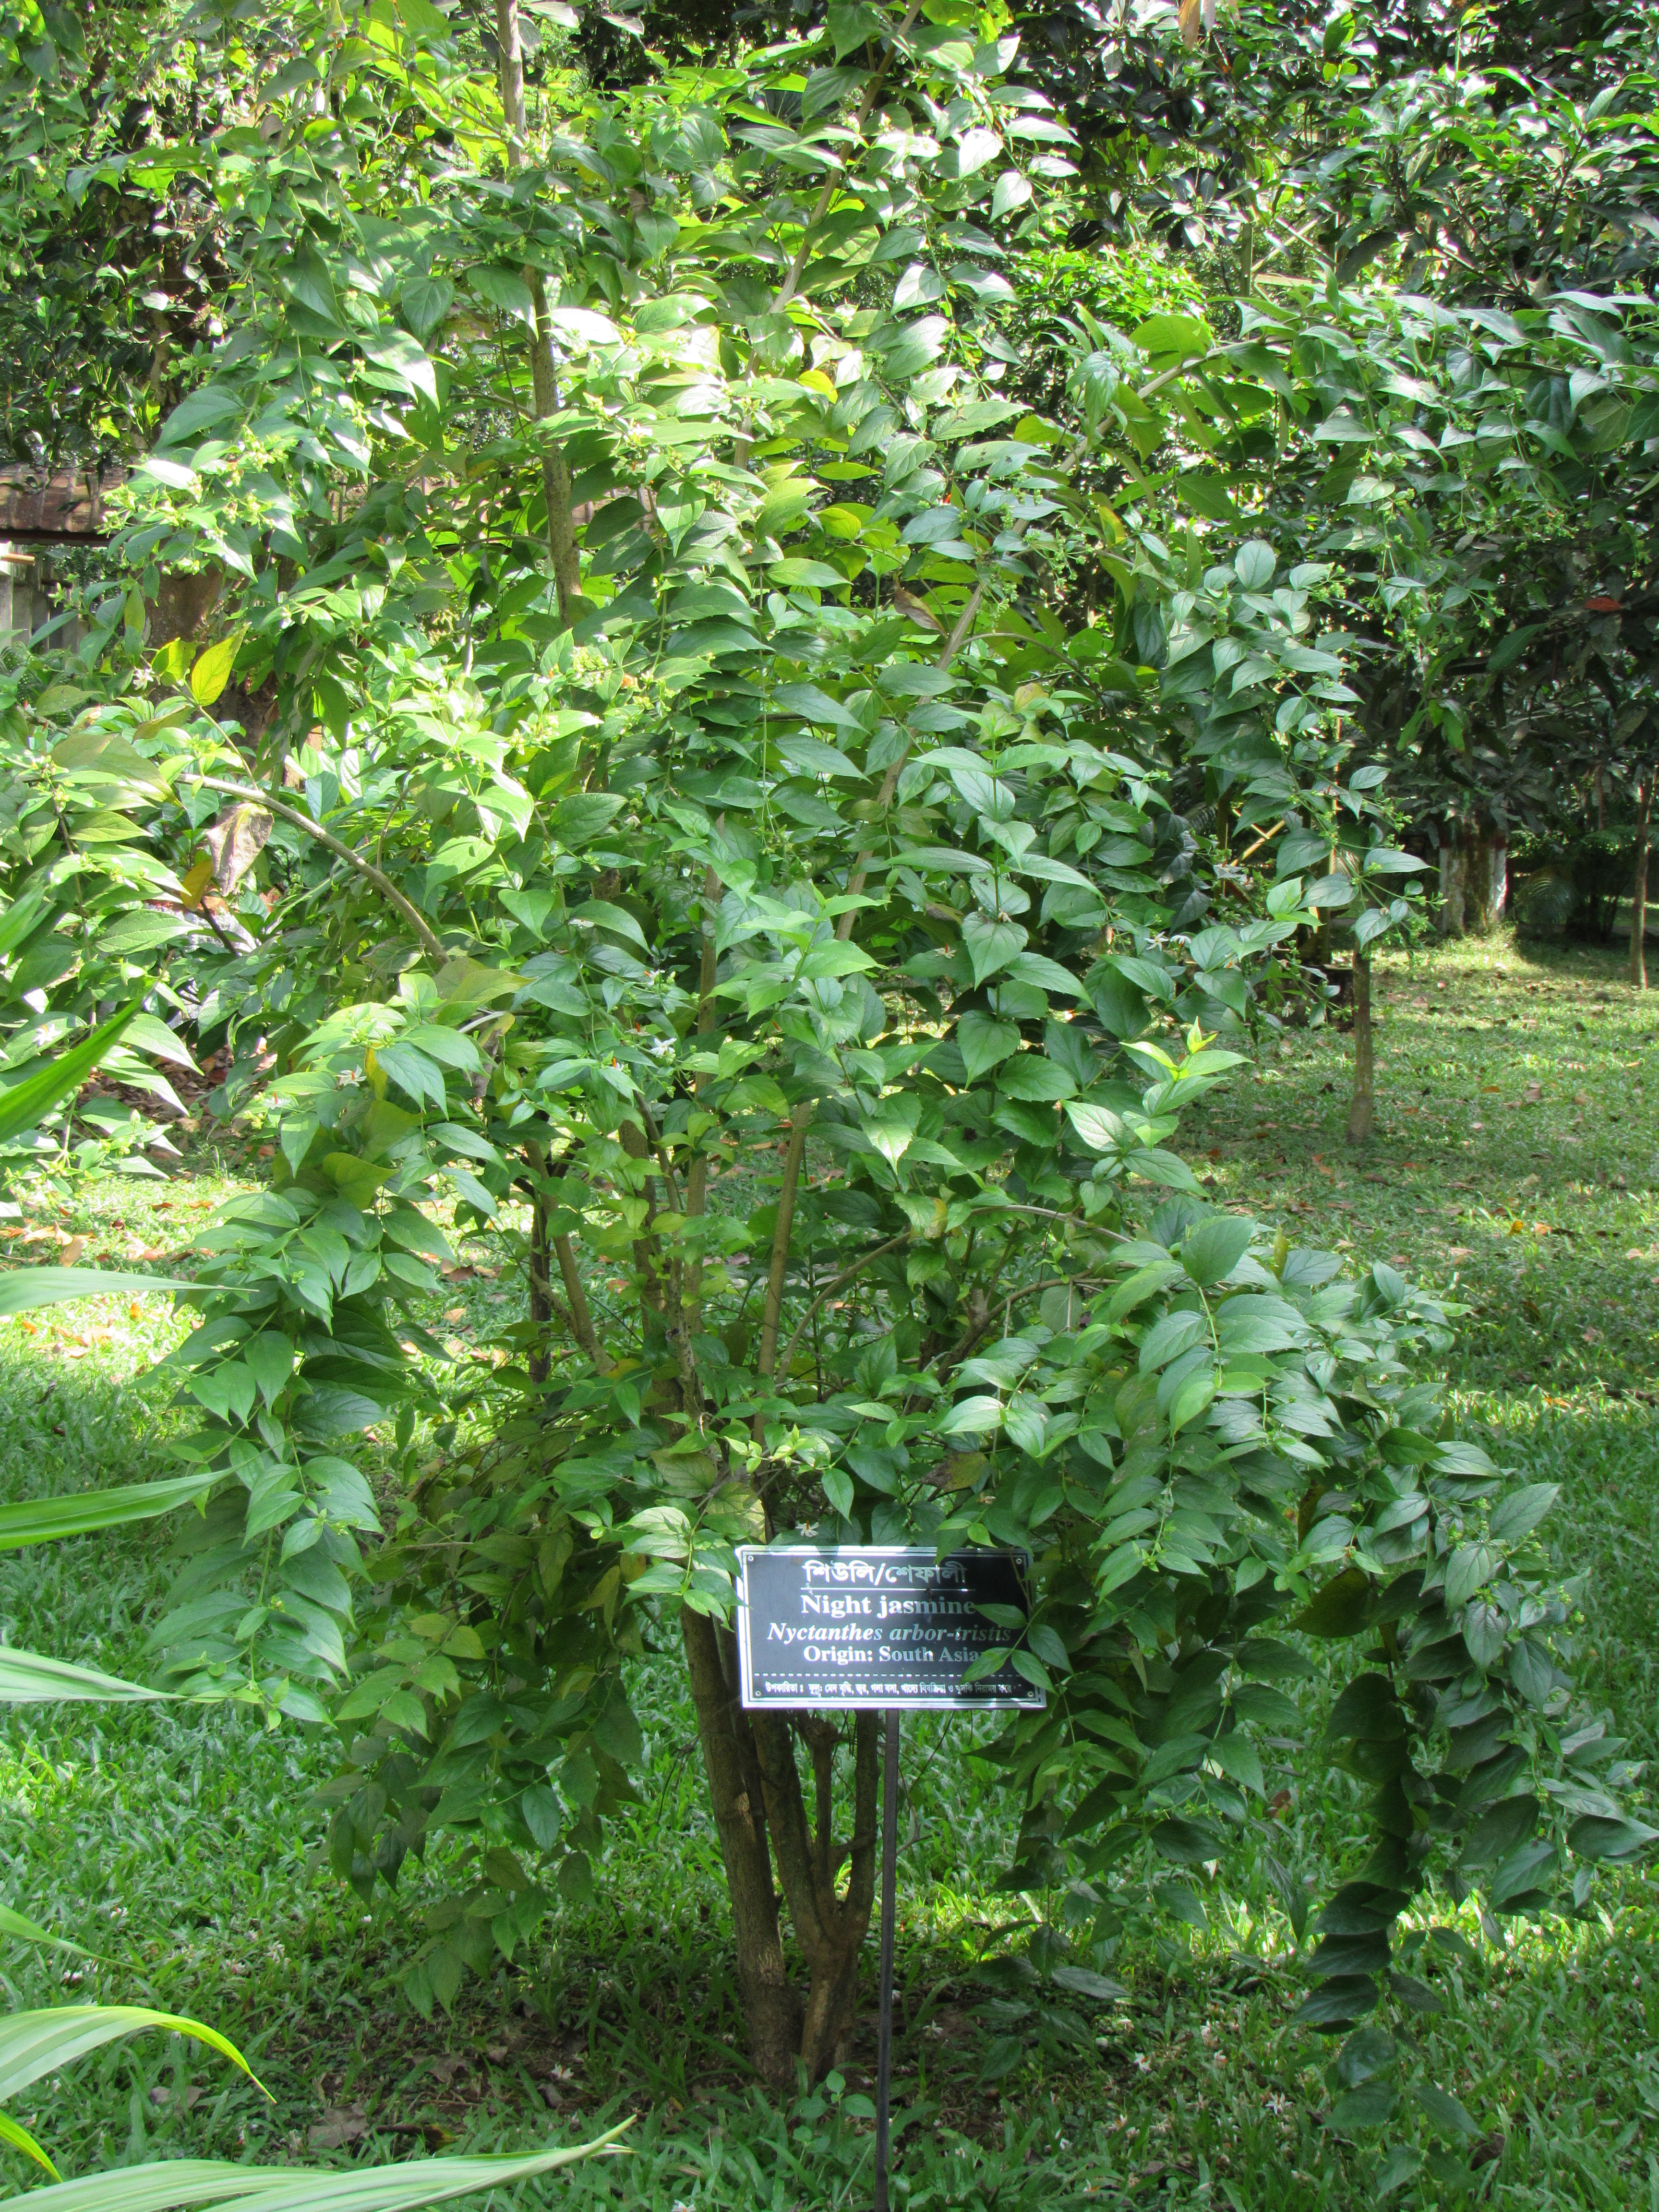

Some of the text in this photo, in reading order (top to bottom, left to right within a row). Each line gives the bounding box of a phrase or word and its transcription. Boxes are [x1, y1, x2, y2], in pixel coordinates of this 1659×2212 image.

[802, 1560, 967, 1586] শিউলি/শেফালী
[800, 1594, 976, 1619] Night jasmine
[767, 1622, 1011, 1645] Nyctanthes arbor-tristis
[803, 1645, 979, 1665] Origin: South Asia
